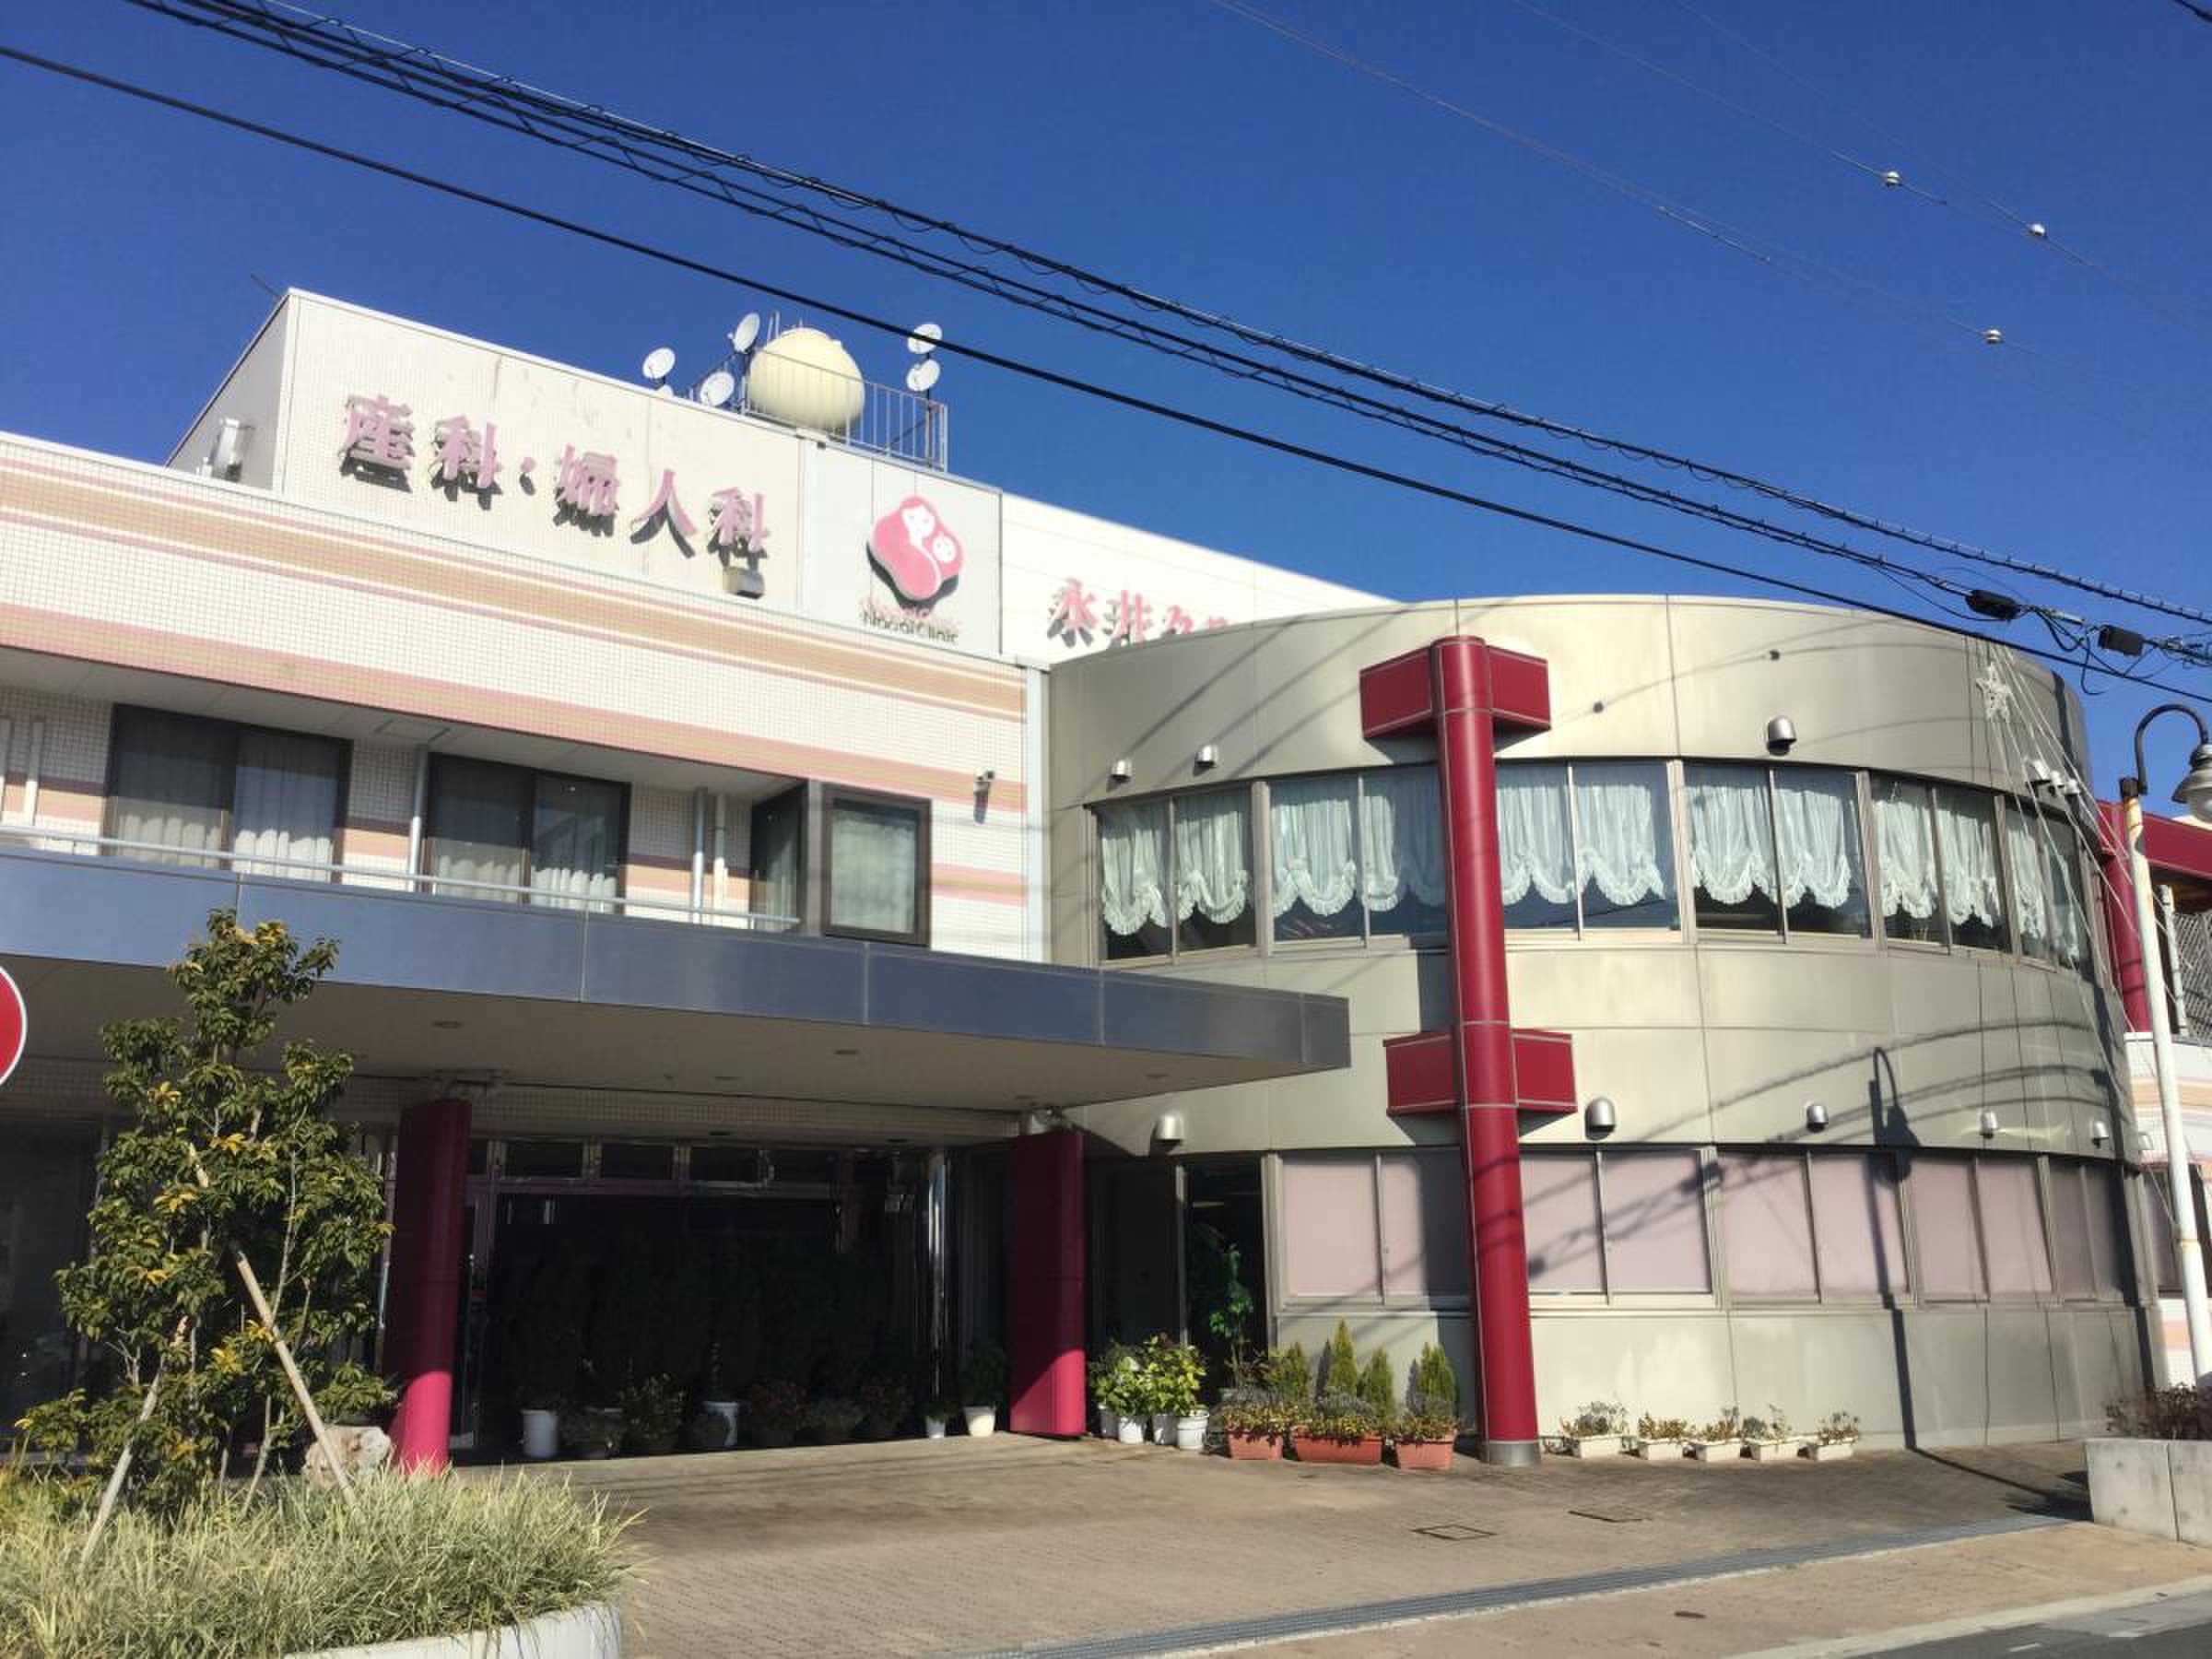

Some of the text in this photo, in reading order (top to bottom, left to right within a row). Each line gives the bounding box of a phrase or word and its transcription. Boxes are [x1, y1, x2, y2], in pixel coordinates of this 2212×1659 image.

[340, 394, 771, 559] 産科・婦人科
